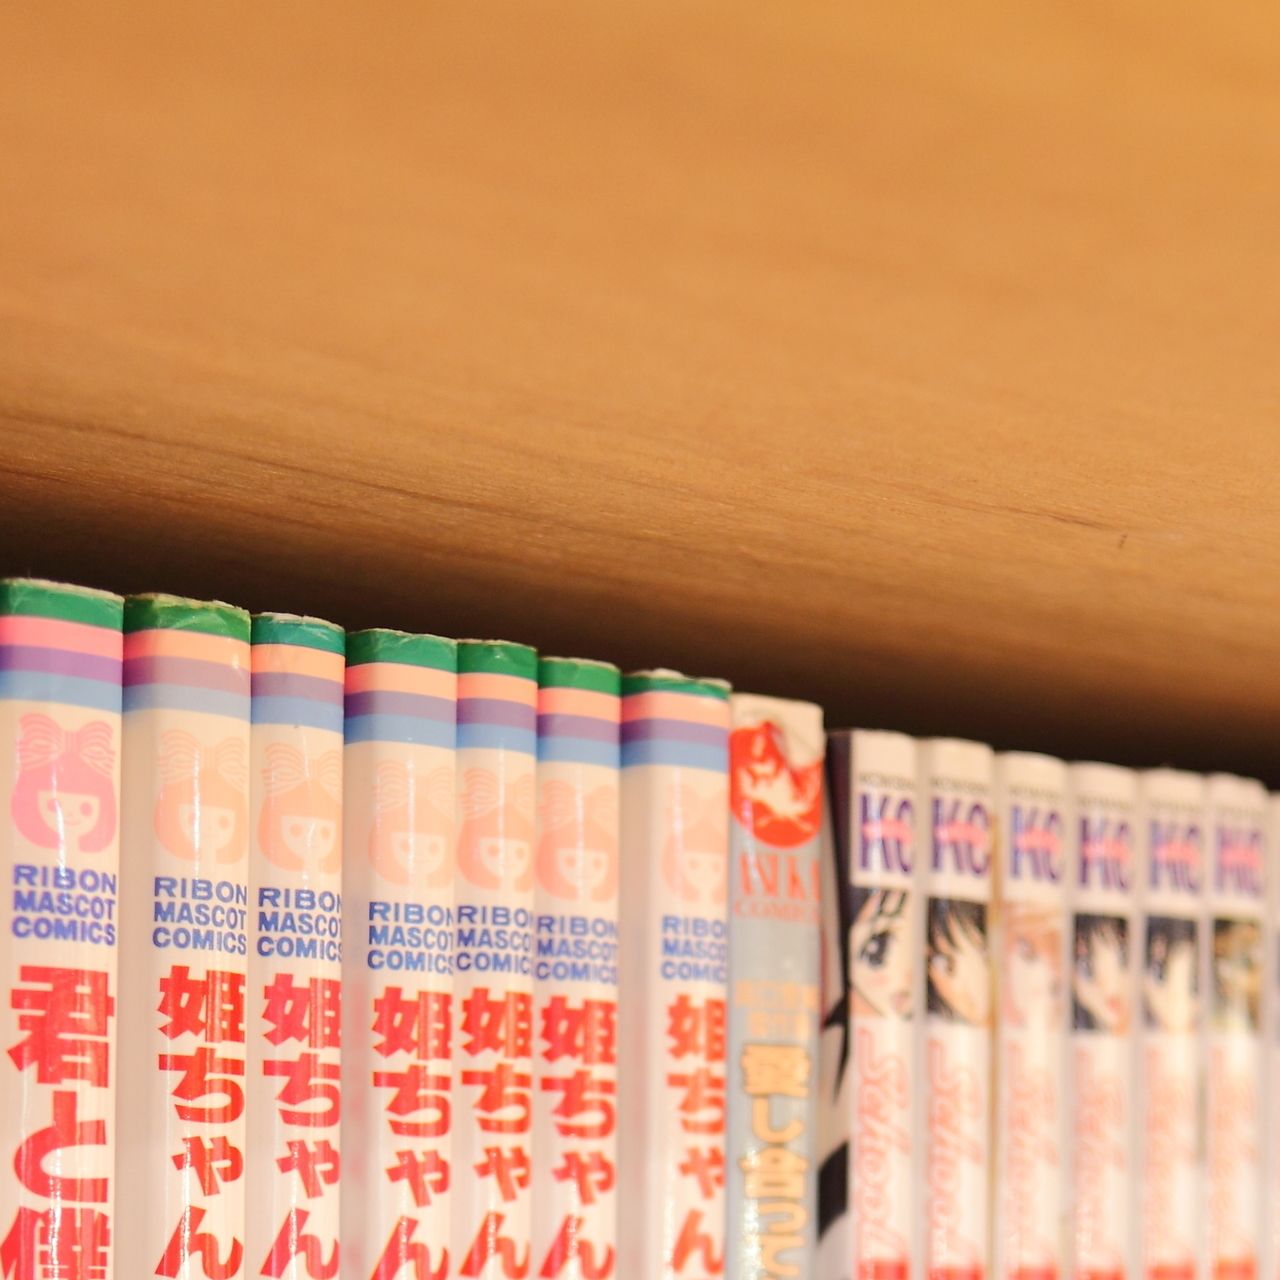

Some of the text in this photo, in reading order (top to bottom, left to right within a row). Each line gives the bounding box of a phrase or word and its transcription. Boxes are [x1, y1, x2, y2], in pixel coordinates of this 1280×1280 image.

[13, 864, 117, 895] RIBON
[154, 876, 247, 905] RIBON
[13, 890, 116, 921] MASCOT
[154, 901, 247, 930] MASCOT
[11, 918, 116, 946] COMICS
[152, 926, 247, 955] COMICS
